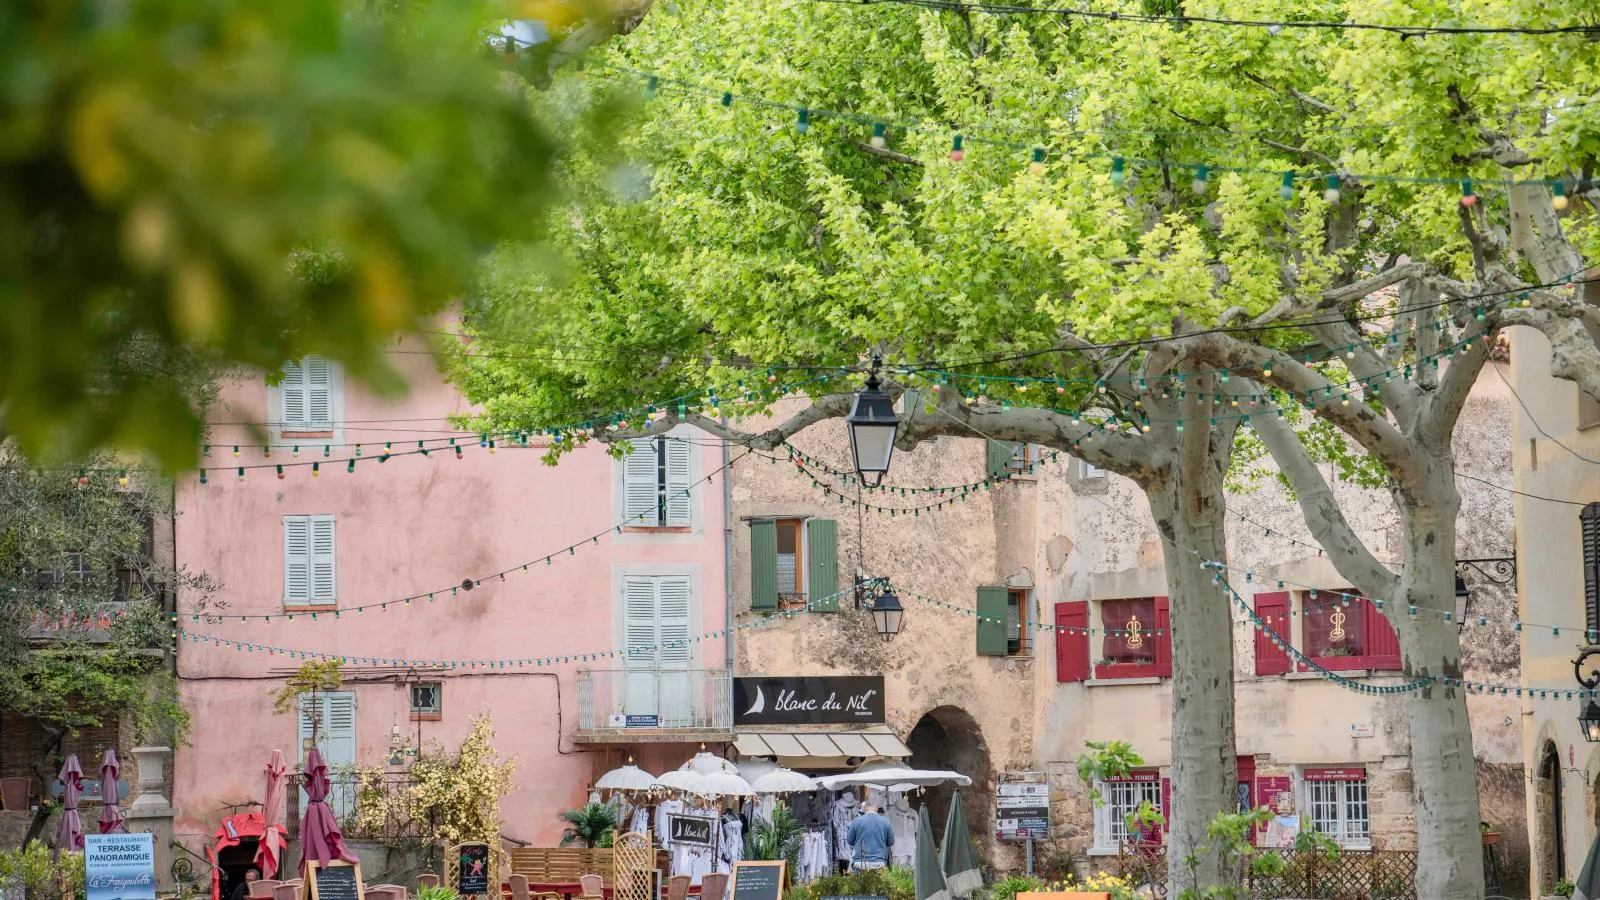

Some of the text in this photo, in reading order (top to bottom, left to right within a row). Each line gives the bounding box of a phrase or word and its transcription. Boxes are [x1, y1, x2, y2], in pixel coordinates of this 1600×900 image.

[821, 692, 841, 710] du
[97, 844, 141, 852] TERRASSE
[89, 853, 151, 861] PANORAMIQUE
